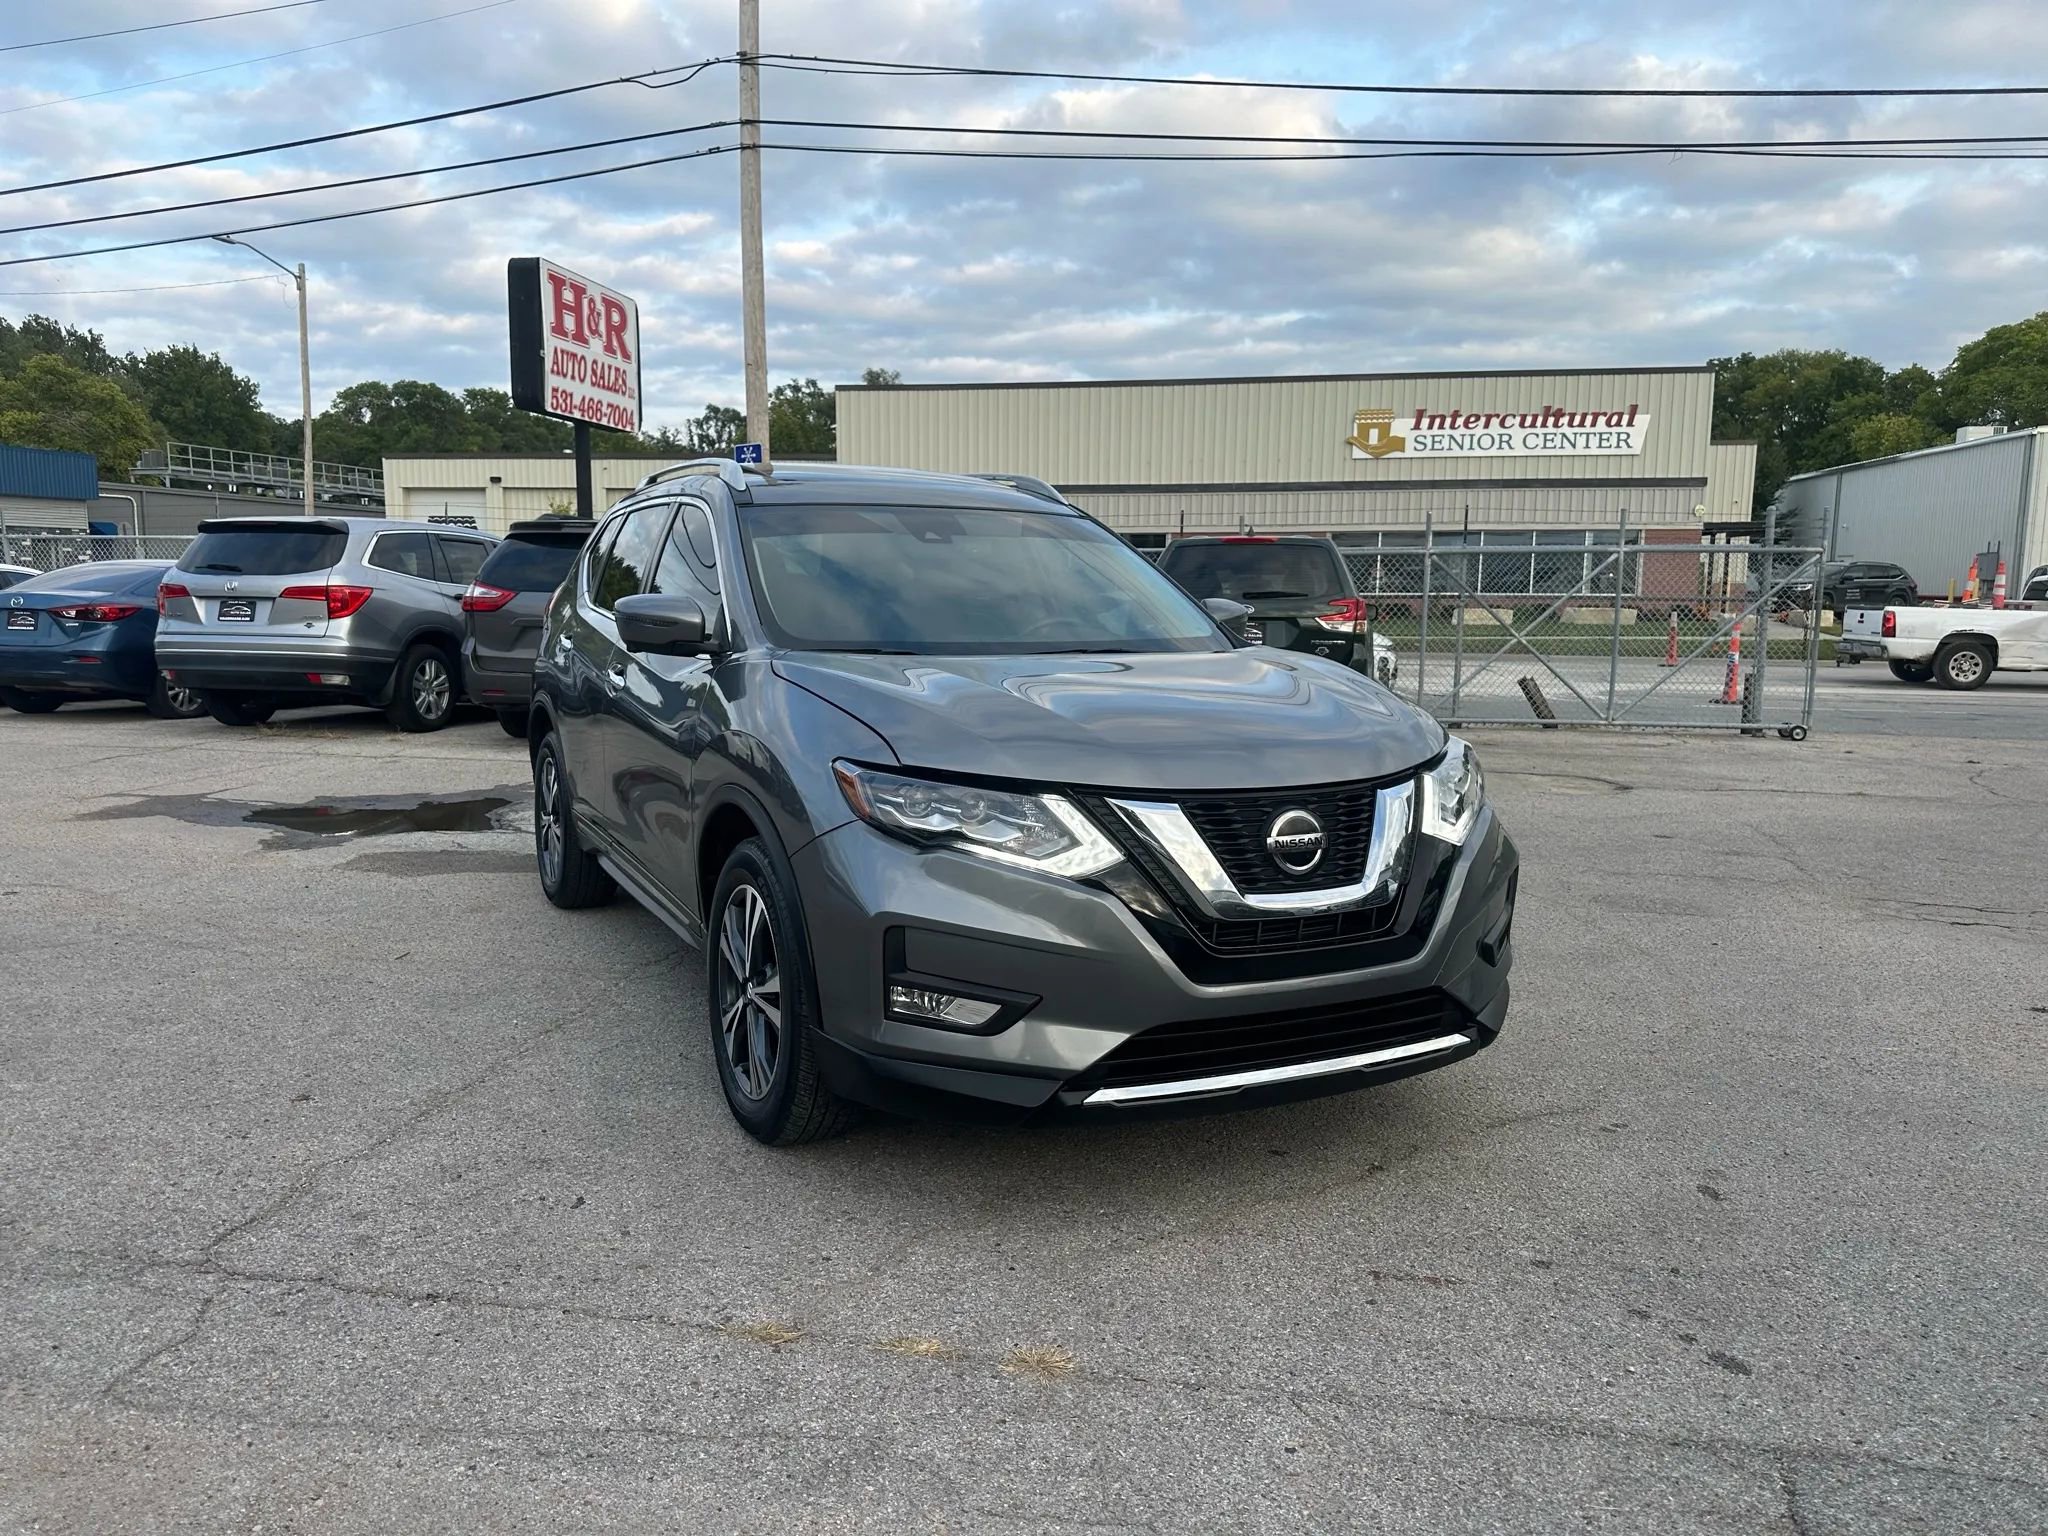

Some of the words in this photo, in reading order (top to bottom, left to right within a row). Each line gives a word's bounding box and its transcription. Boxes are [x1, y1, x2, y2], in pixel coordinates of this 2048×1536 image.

[547, 269, 632, 363] H&R
[551, 347, 587, 382] AUTO
[590, 359, 627, 396] SALES
[551, 386, 635, 430] 531-466-7004
[1410, 404, 1639, 431] Intercultural
[1413, 433, 1514, 452] SENIOR
[1522, 431, 1634, 450] CENTER
[1274, 837, 1323, 848] NISSAN
